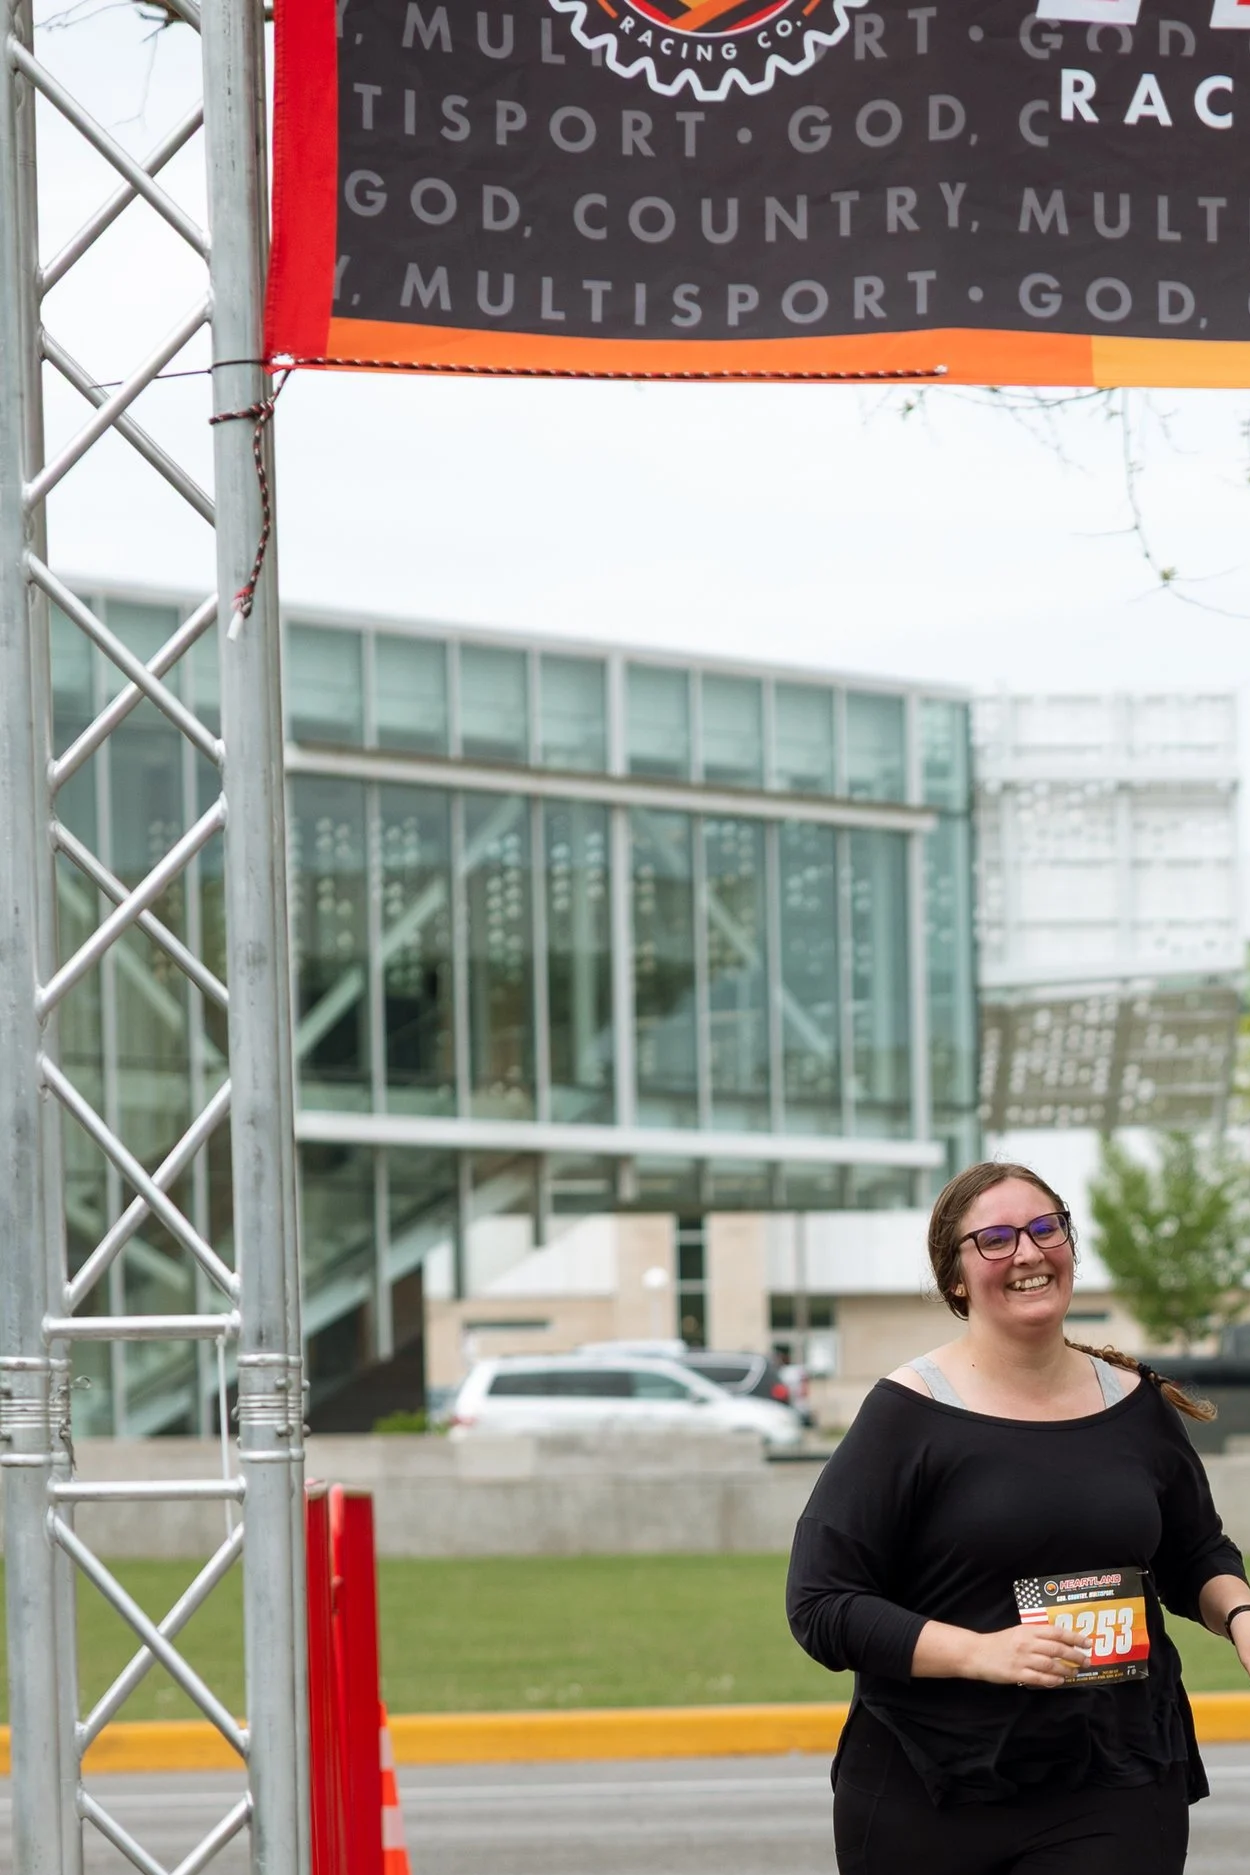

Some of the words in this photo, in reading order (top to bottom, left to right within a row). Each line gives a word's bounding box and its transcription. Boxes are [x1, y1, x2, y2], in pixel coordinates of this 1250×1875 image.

[619, 15, 738, 62] RACING
[757, 18, 803, 49] CO.
[353, 83, 706, 158] TISPORT
[788, 94, 979, 154] GOD,
[344, 169, 532, 239] GOD,
[574, 182, 980, 245] COUNTRY,
[400, 262, 938, 328] MULTISPORT
[1018, 272, 1209, 330] GOD,
[1060, 1574, 1122, 1590] HEARTLAND
